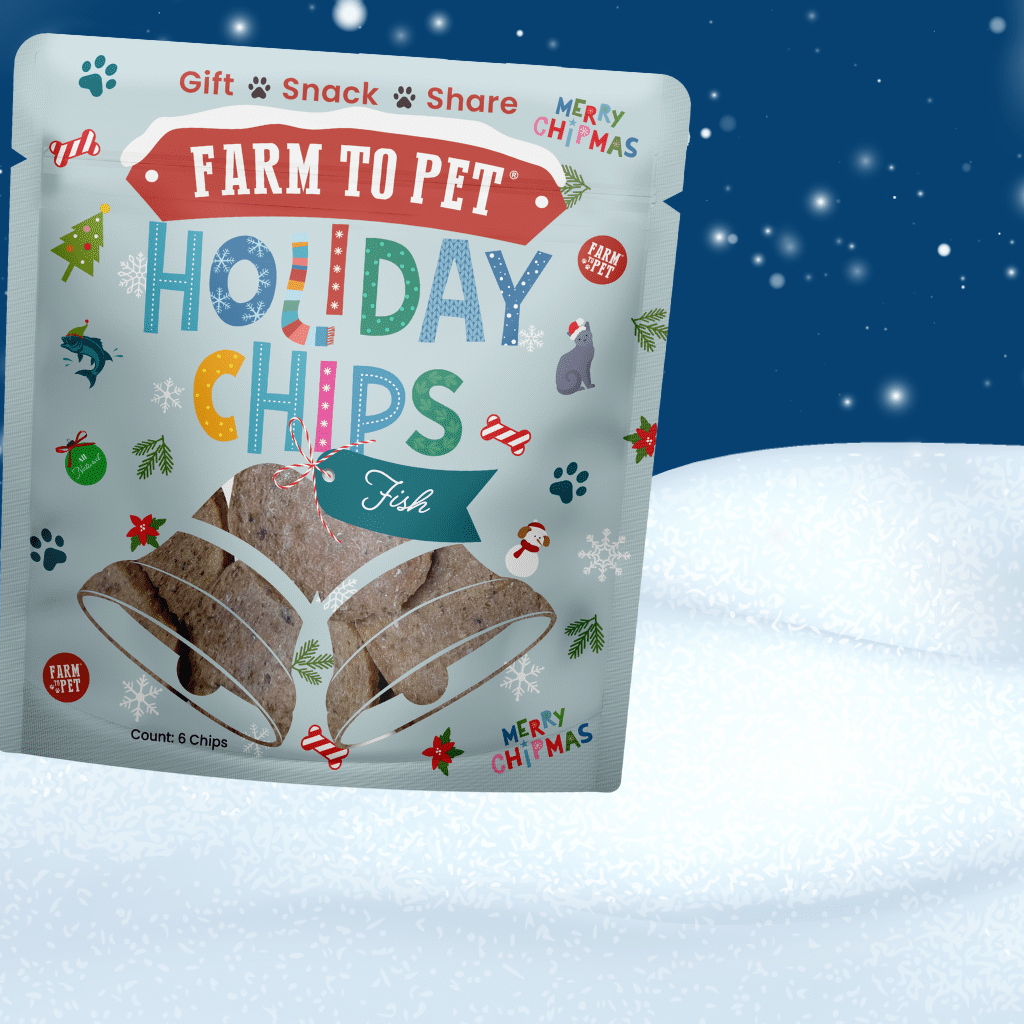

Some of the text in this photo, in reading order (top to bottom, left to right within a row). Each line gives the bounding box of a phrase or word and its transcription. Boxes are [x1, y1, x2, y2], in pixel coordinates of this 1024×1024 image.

[179, 69, 518, 115] Gift Snack Share
[555, 96, 625, 128] MERRY
[190, 142, 323, 198] FARM
[340, 144, 397, 200] TO
[587, 241, 622, 266] FARM
[590, 258, 615, 279] PET
[143, 221, 553, 347] HOLIDAY
[193, 341, 464, 455] CHIPS
[361, 469, 434, 513] Fish
[49, 663, 81, 679] FARM
[60, 678, 81, 693] PET
[130, 728, 228, 751] Count: 6 Chips
[501, 707, 565, 746] MERRY
